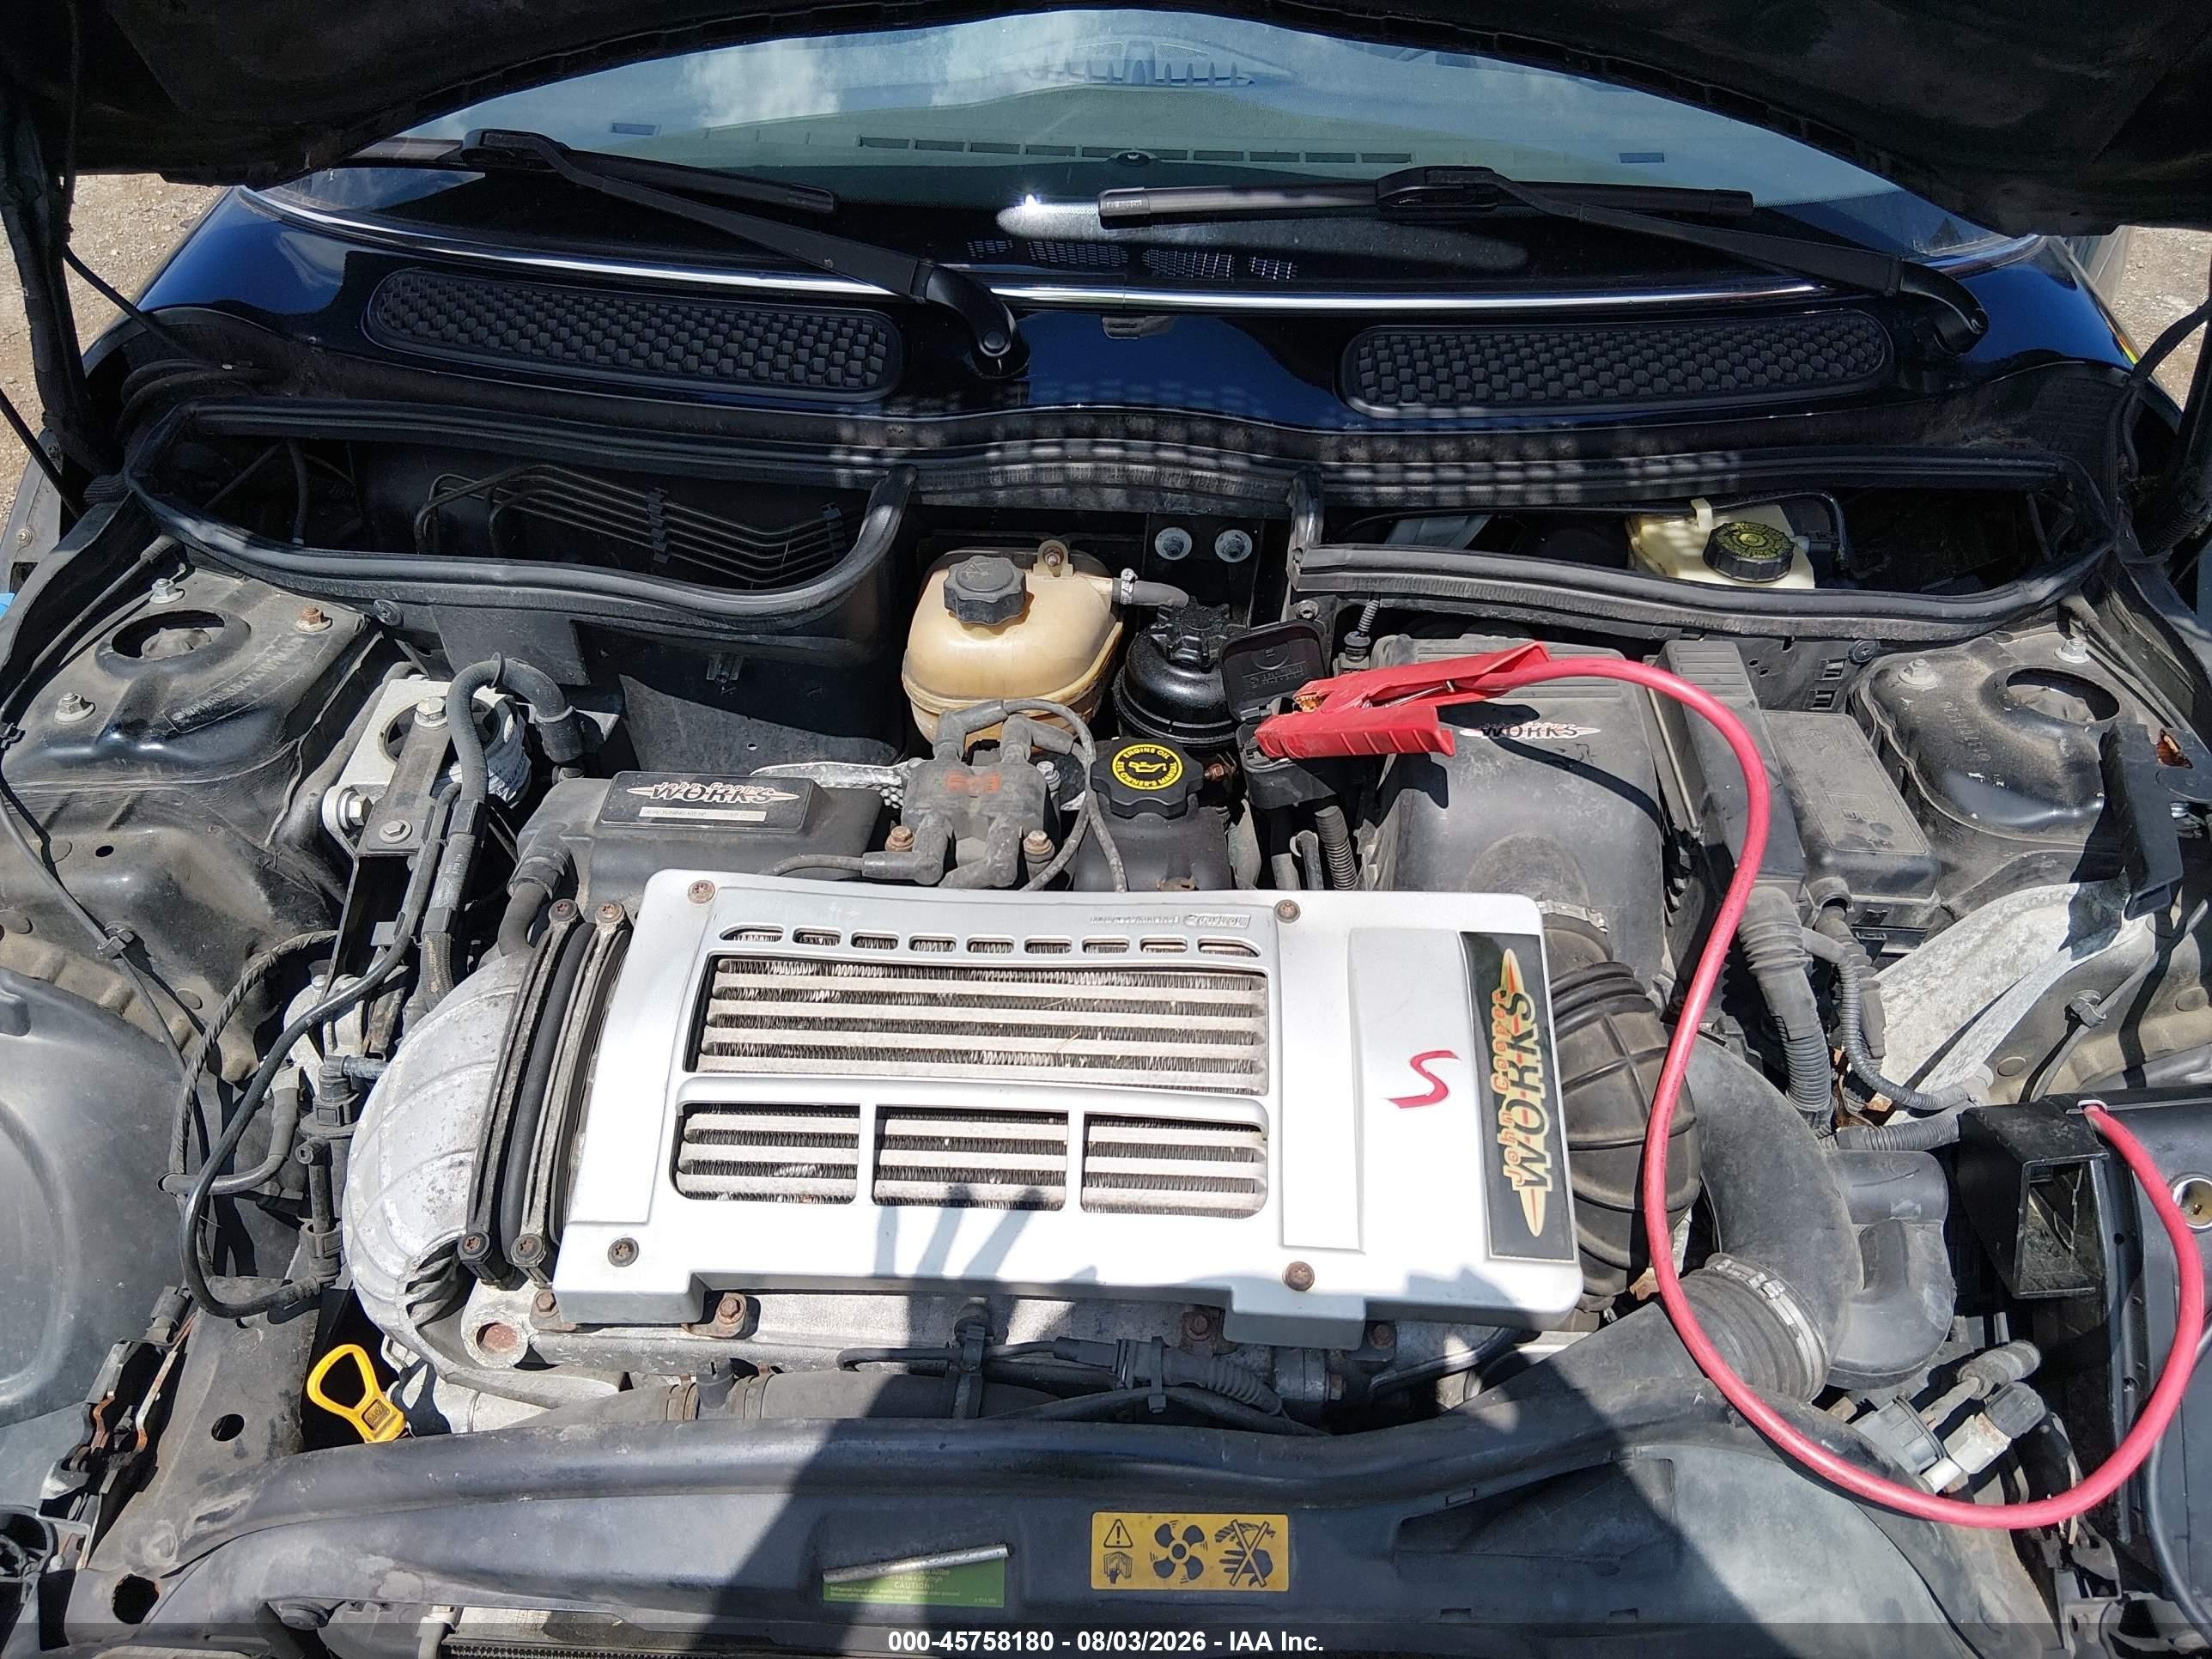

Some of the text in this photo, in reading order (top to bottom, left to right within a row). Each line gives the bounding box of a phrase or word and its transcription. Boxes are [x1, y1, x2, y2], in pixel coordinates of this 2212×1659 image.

[1481, 725, 1578, 738] WORKS
[1123, 747, 1170, 760] ENGINE OIL
[1120, 772, 1158, 787] OWNER'S
[1158, 762, 1178, 785] MANUAL
[651, 784, 774, 804] WORKS
[659, 781, 775, 795] John Cooper
[1382, 1050, 1461, 1109] S
[1492, 990, 1523, 1187] John Cooper
[1499, 993, 1548, 1188] WORKS
